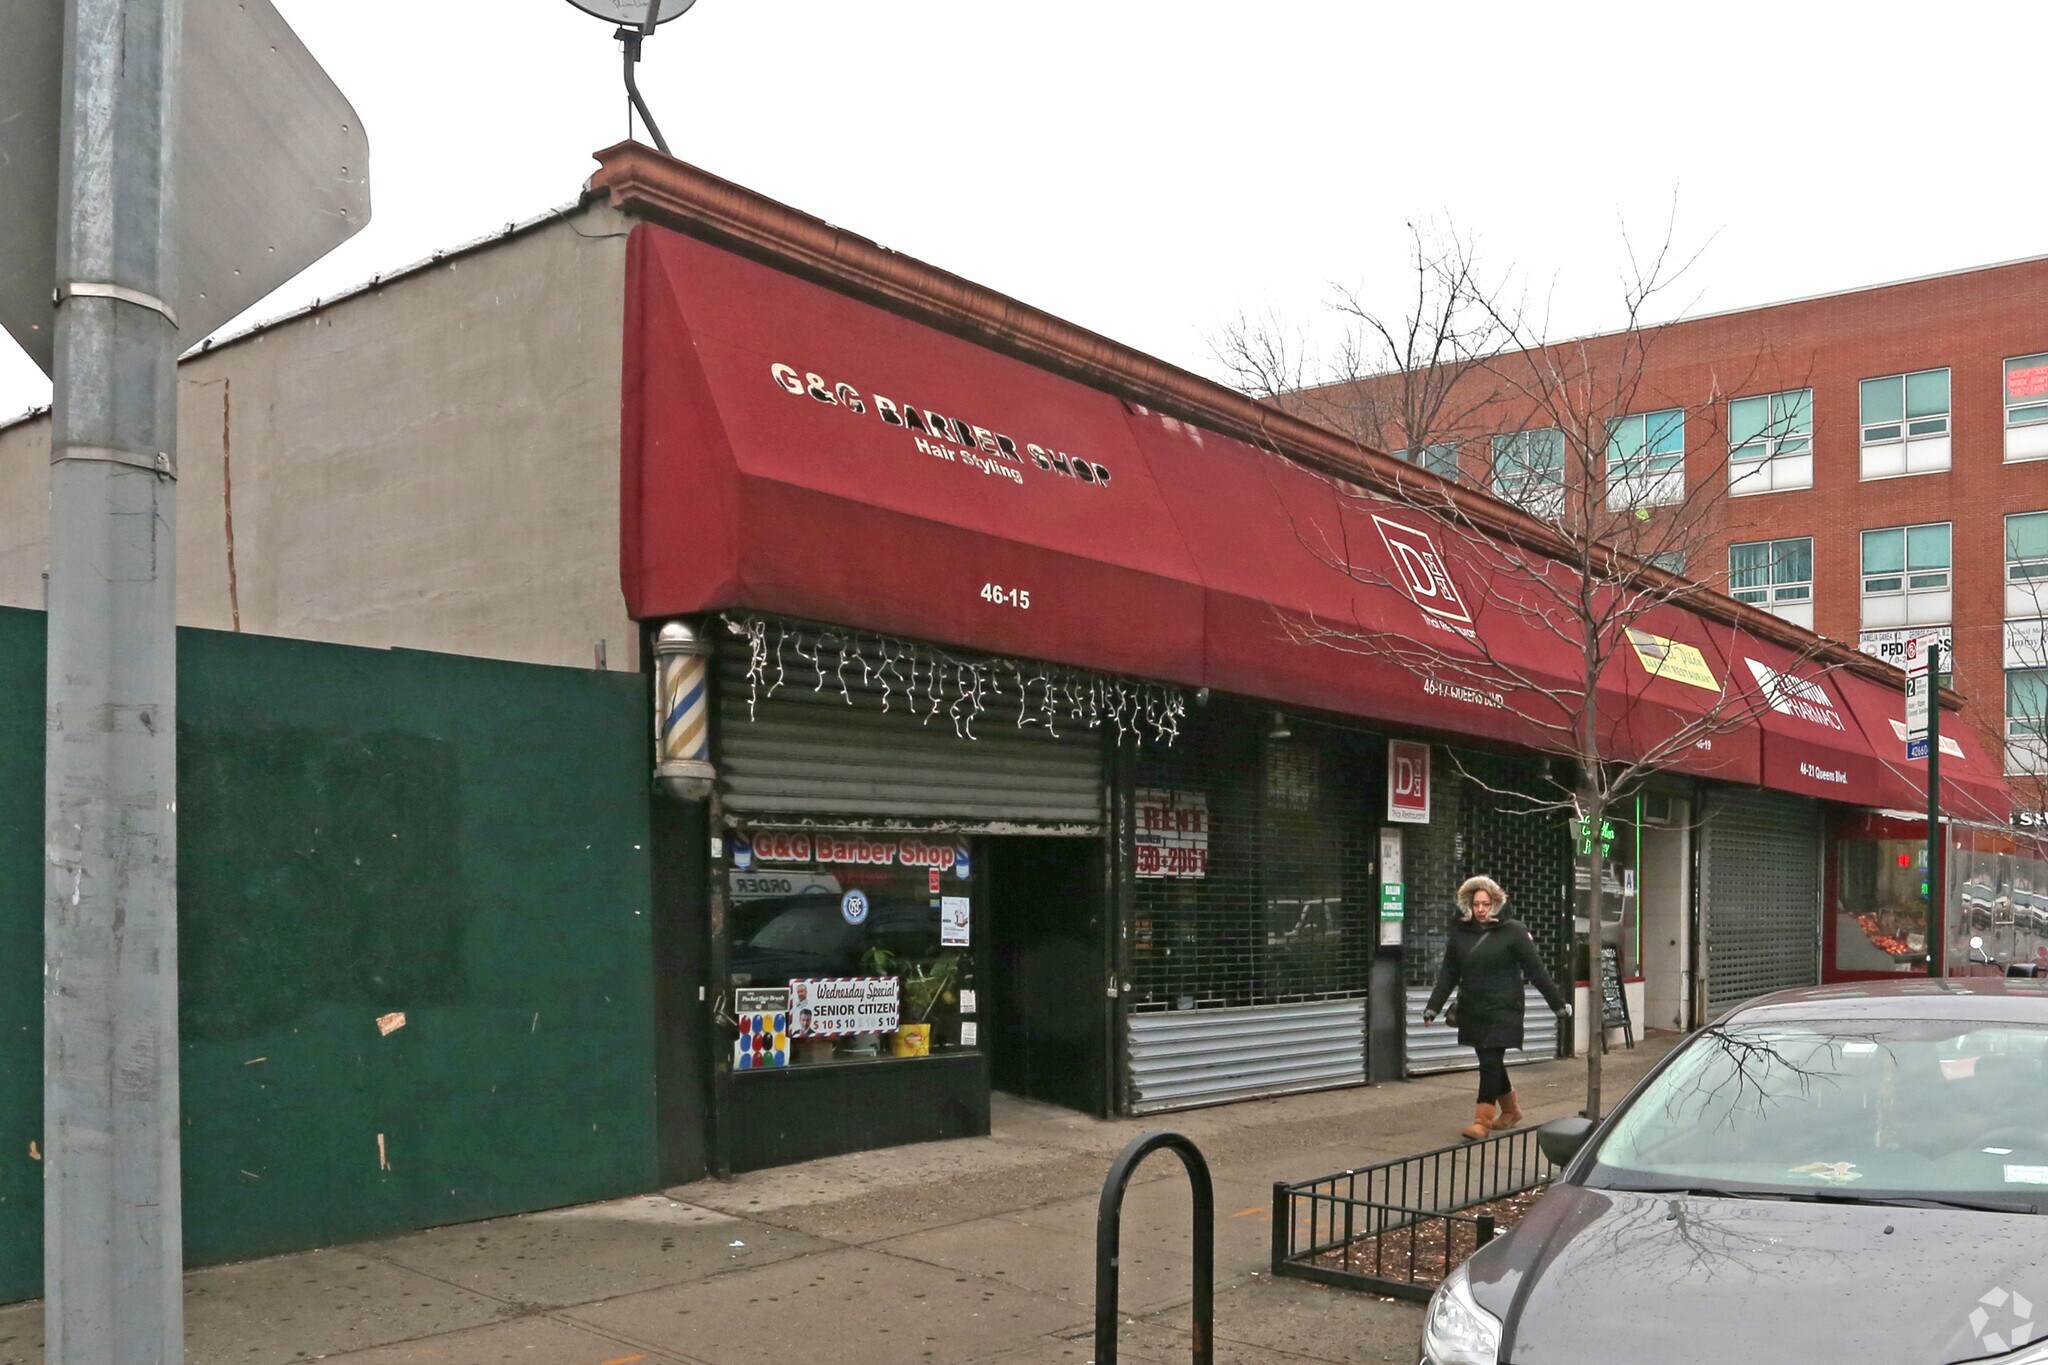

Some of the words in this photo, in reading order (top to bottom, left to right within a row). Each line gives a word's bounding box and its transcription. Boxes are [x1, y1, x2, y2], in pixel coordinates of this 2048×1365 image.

[770, 362, 866, 415] G&G
[873, 393, 1024, 464] BARBER
[1026, 443, 1112, 488] SHOP
[914, 436, 956, 463] Hair
[960, 450, 1024, 485] Styling
[980, 582, 1030, 609] 46-15
[1907, 679, 1914, 696] 2
[1783, 695, 1846, 731] PHARMACY
[1800, 761, 1815, 778] 46-21
[1815, 765, 1835, 782] Queens
[753, 831, 811, 862] G&G
[815, 835, 897, 865] Barber
[899, 839, 955, 871] Shop
[1135, 846, 1207, 874] 50-2061
[816, 983, 865, 1002] Wednesday
[866, 982, 895, 1001] Special
[813, 1005, 855, 1017] SENIOR
[857, 1003, 896, 1015] CITIZEN
[813, 1020, 819, 1030] $
[822, 1020, 833, 1029] 10
[836, 1019, 842, 1029] $
[845, 1019, 855, 1028] 10
[878, 1017, 883, 1027] $
[886, 1017, 896, 1026] 10
